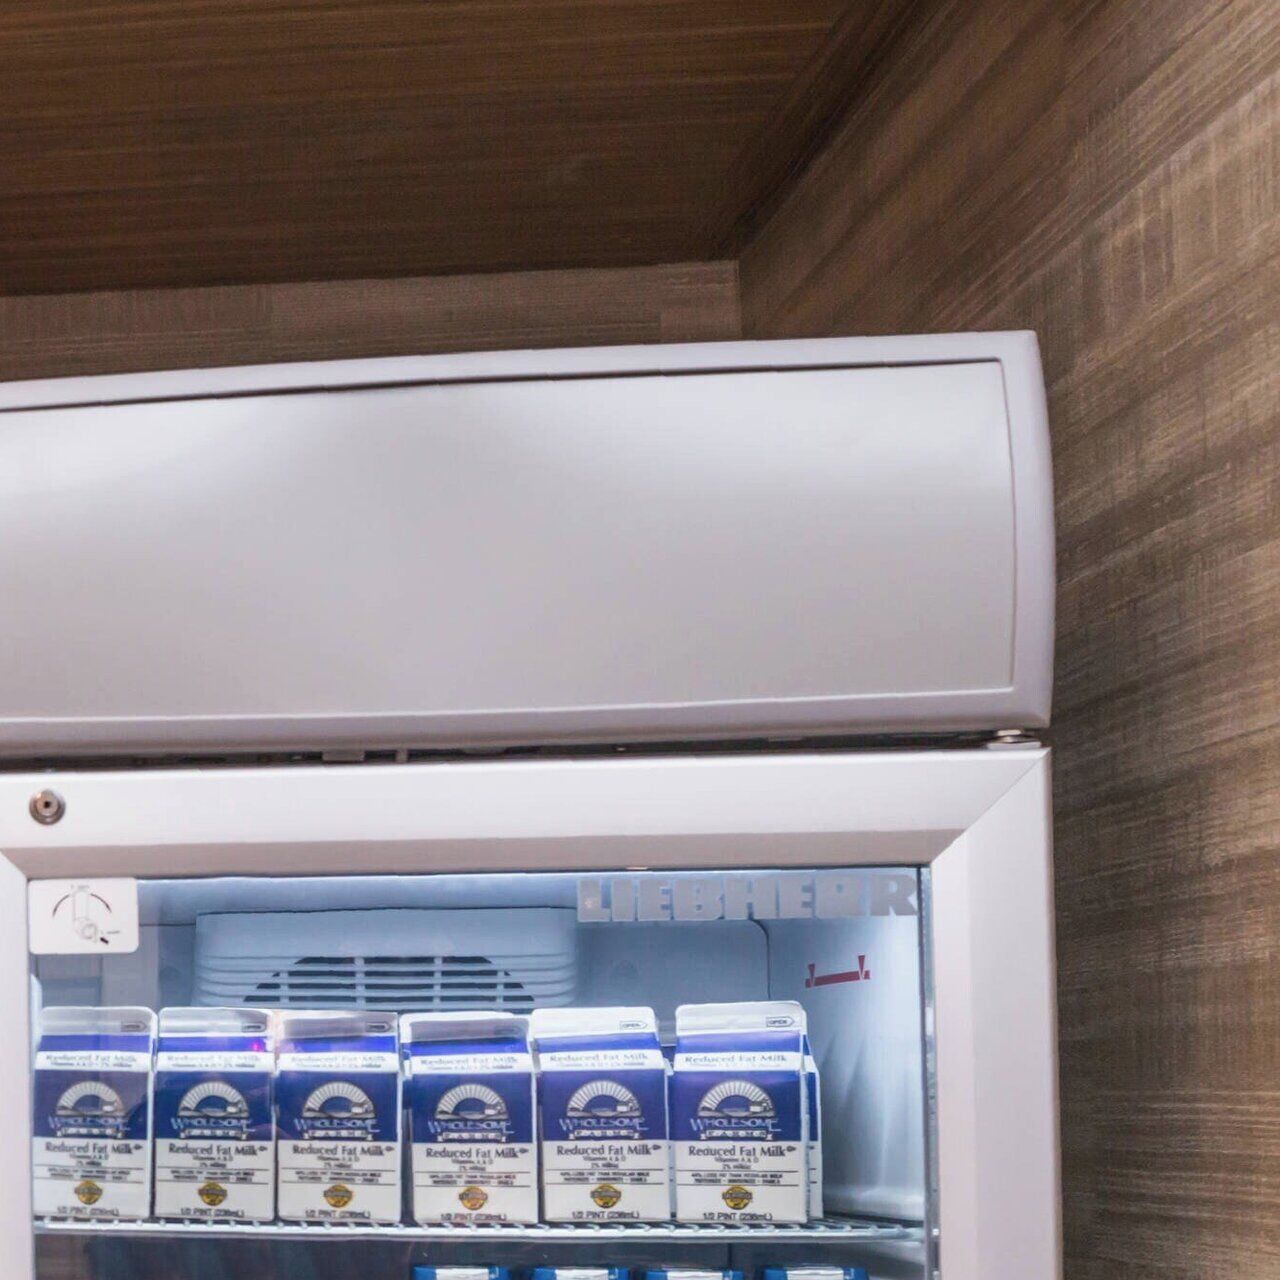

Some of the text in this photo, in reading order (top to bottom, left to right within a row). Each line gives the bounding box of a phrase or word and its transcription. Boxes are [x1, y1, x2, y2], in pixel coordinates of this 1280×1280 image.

[577, 874, 917, 922] LIEBHERR
[428, 1120, 515, 1134] WHOLESOME
[559, 1118, 649, 1131] WHOLESOME
[690, 1118, 782, 1132] WHOLESOME
[45, 1141, 133, 1154] Reduced Fat Milk
[169, 1143, 257, 1156] Reduced Fat Milk
[292, 1144, 384, 1156] Reduced Fat Milk
[426, 1146, 519, 1158] Reduced Fat Milk
[557, 1144, 652, 1155] Reduced Fat Milk
[688, 1145, 786, 1156] Reduced Fat Milk
